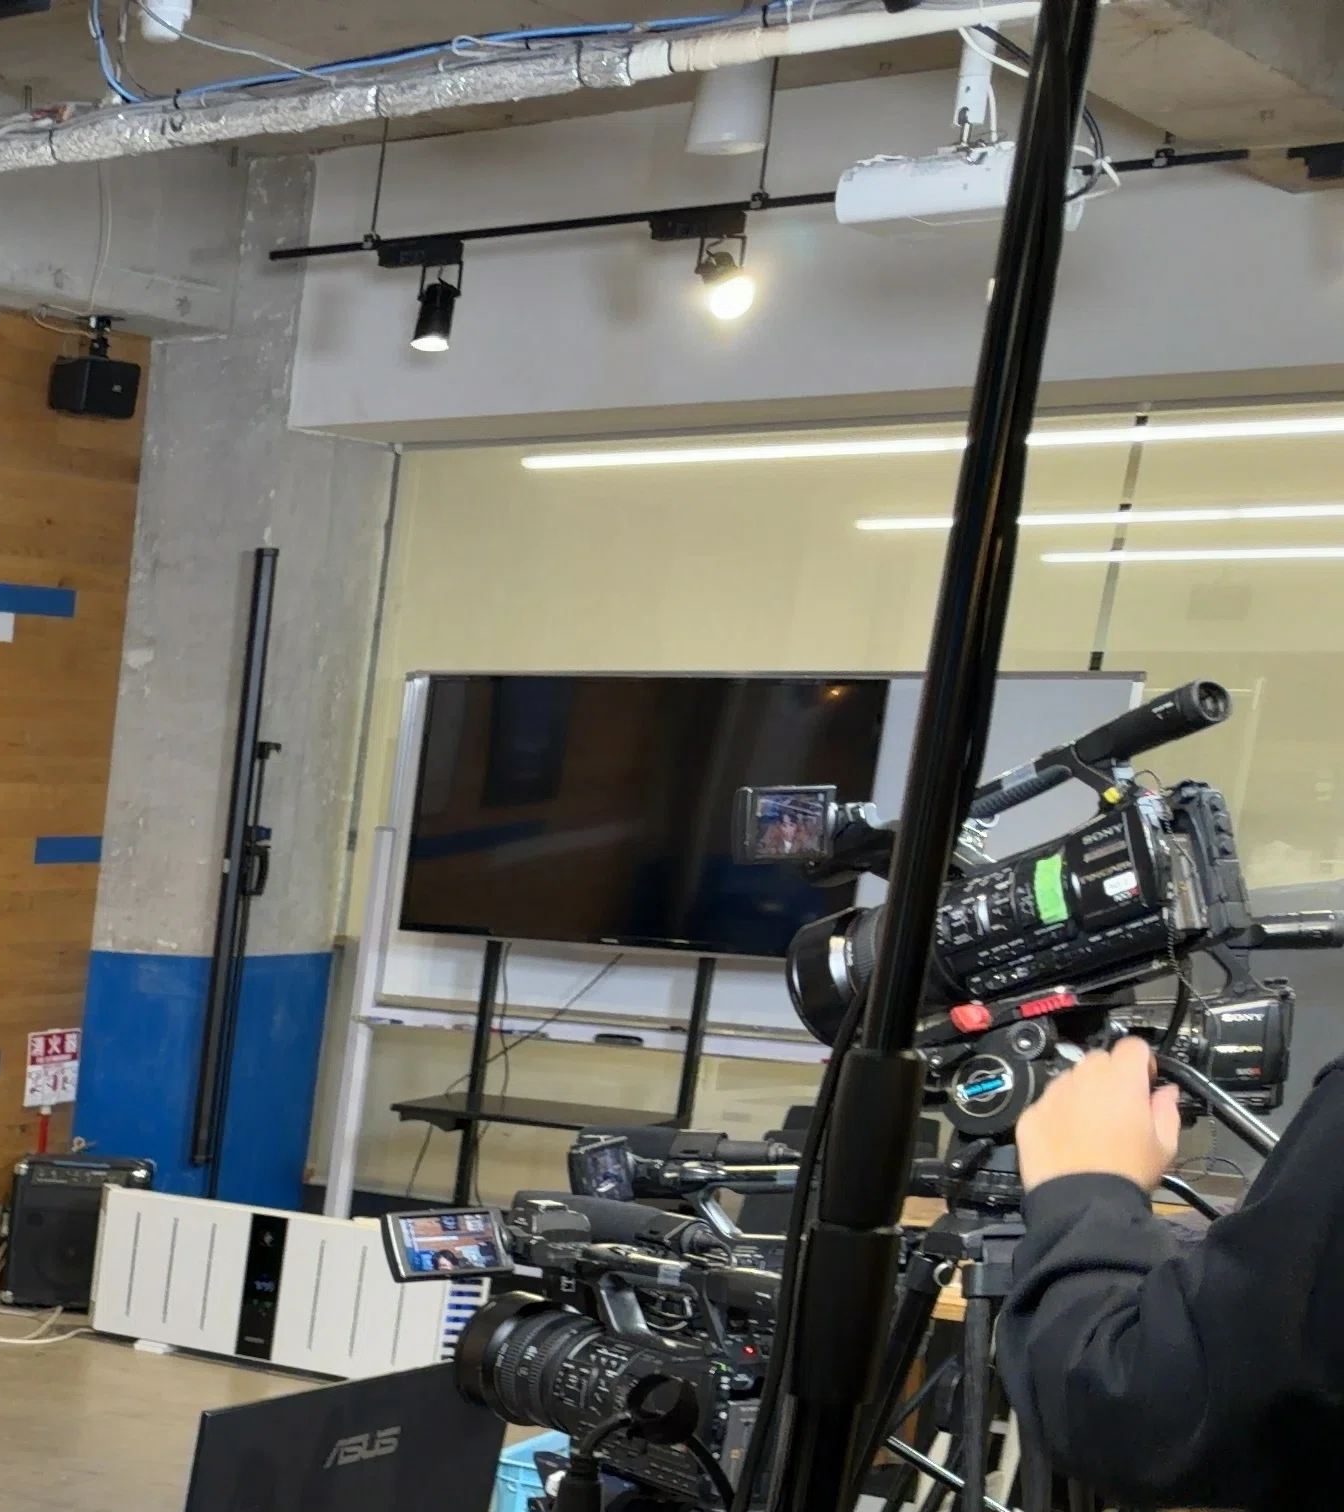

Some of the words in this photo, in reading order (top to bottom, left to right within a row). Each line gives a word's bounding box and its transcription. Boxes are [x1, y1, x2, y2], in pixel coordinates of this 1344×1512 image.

[1082, 823, 1123, 846] SONY
[1221, 1013, 1265, 1022] SONY
[323, 1425, 401, 1469] ASUS
